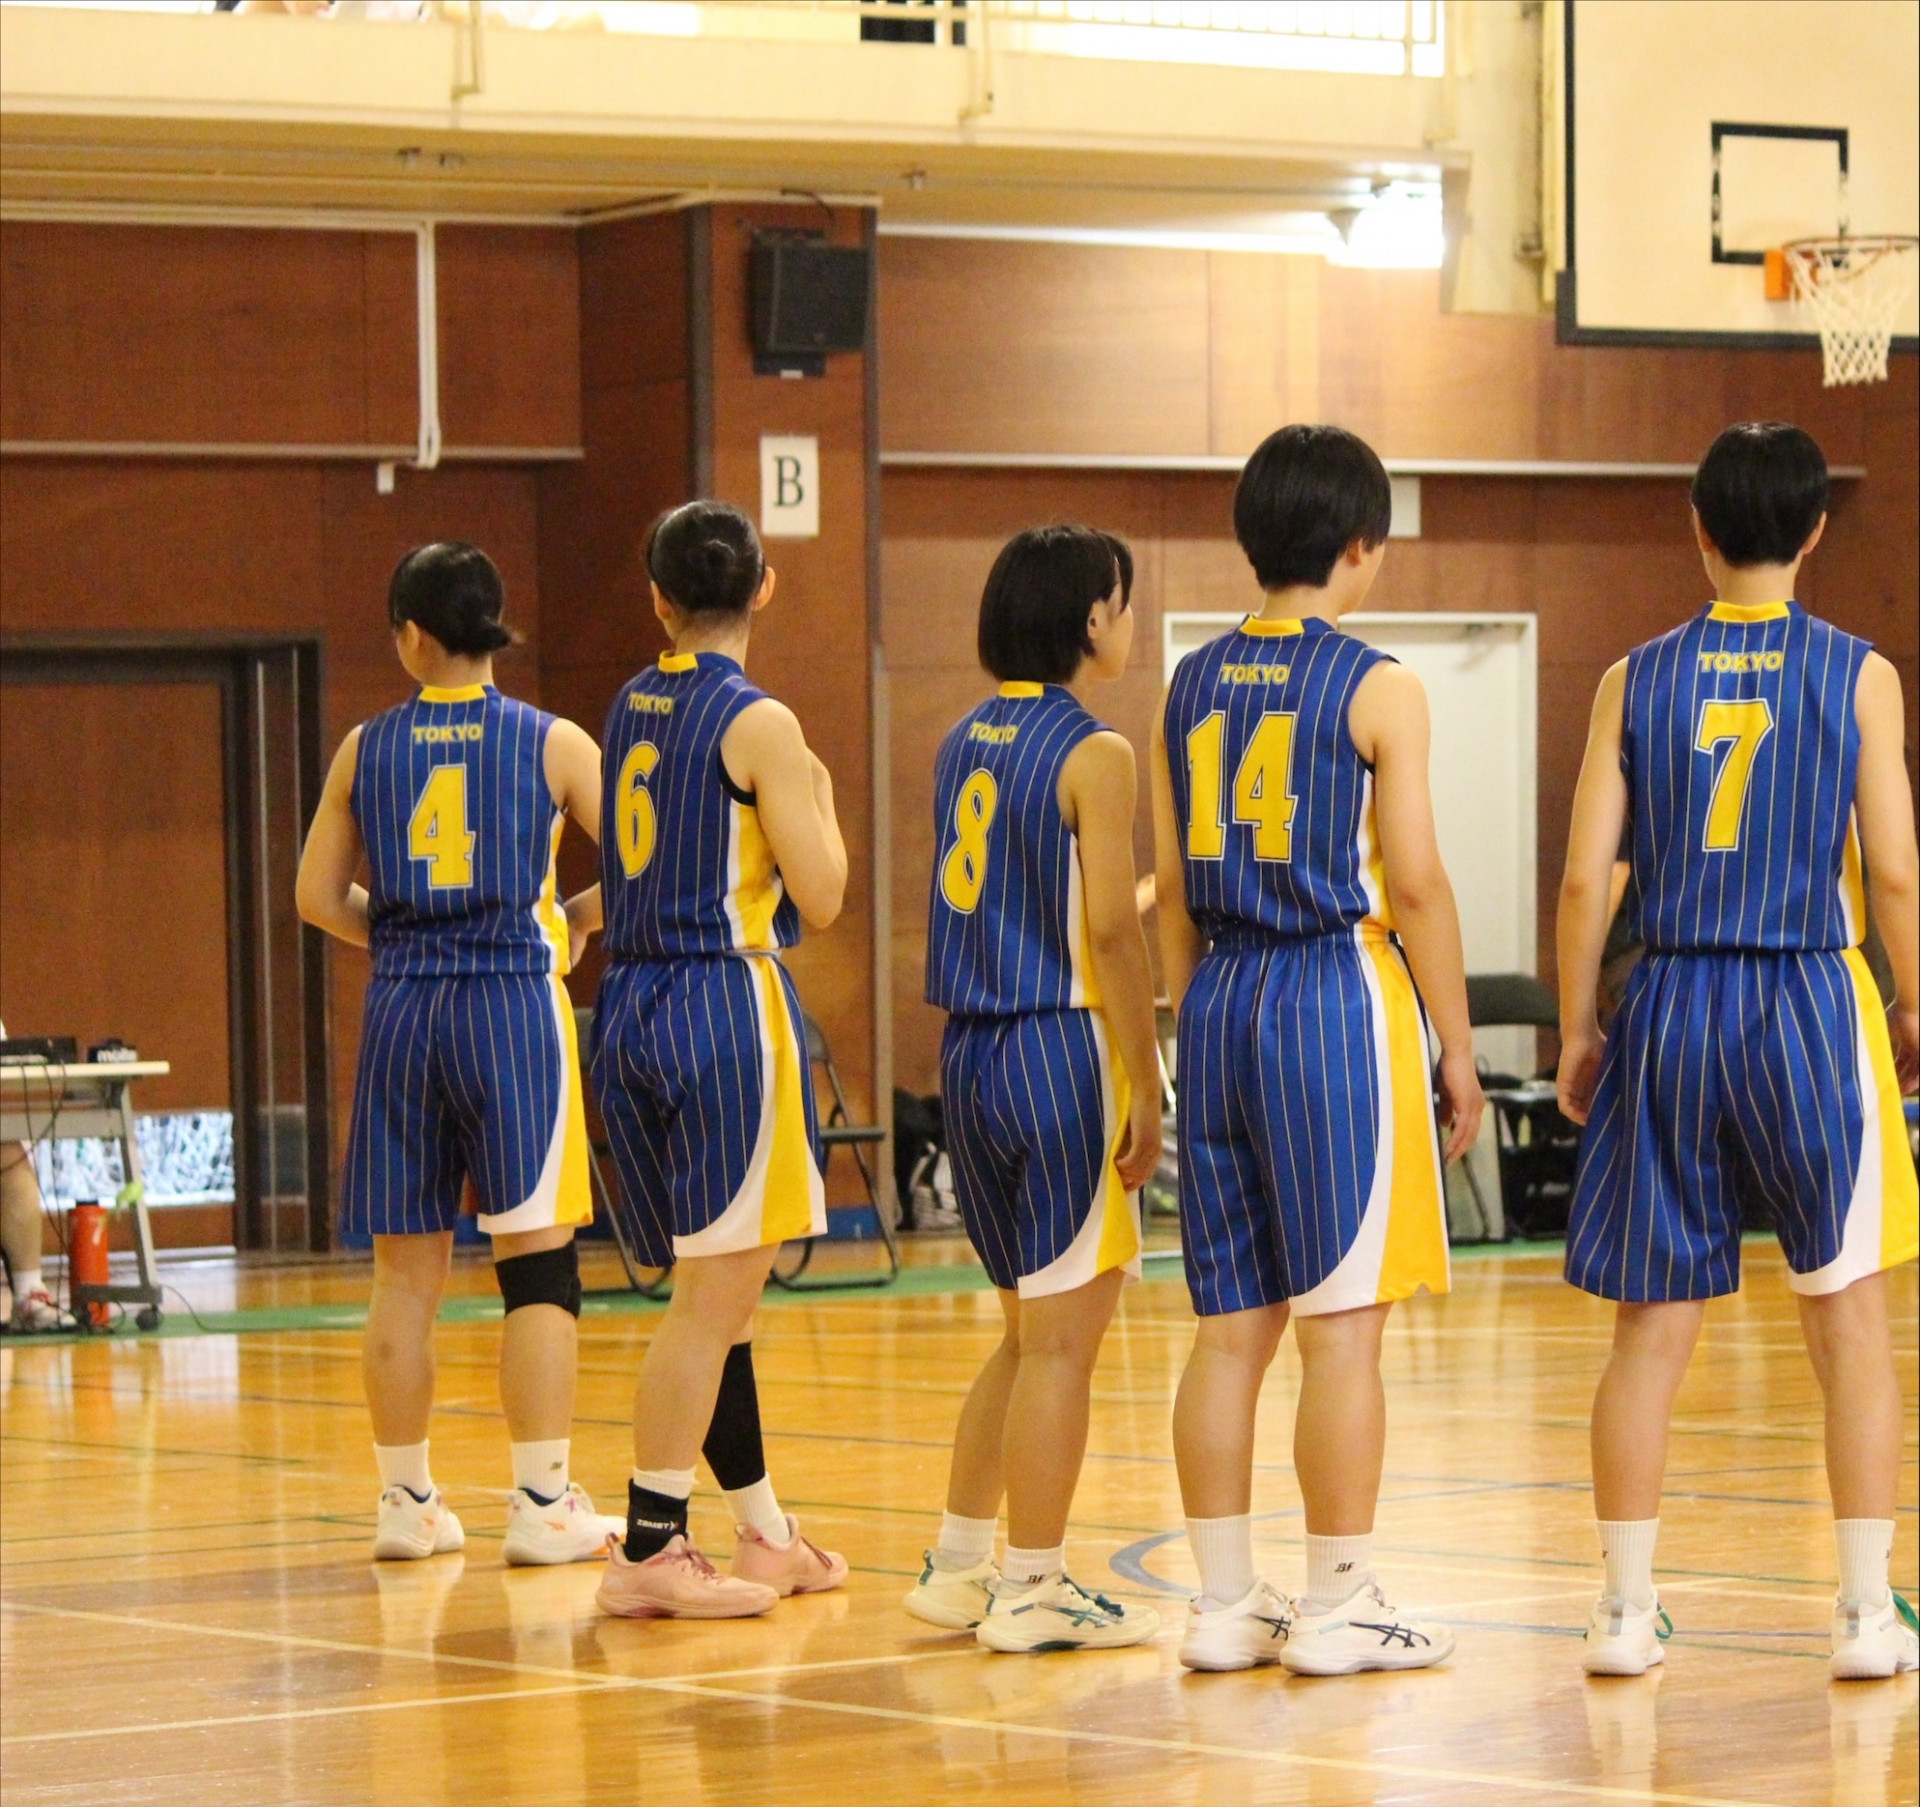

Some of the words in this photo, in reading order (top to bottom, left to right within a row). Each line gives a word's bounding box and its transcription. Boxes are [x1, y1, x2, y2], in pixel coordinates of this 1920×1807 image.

[773, 455, 804, 508] B
[1221, 663, 1290, 685] TOKYO
[1700, 650, 1783, 673] TOKYO
[628, 692, 673, 715] TOKYO
[412, 723, 483, 744] TOKYO
[968, 721, 1019, 744] TOKYO
[1187, 710, 1298, 863] 14
[1694, 698, 1774, 852] 7
[407, 763, 476, 889] 4
[615, 741, 660, 880] 6
[940, 768, 997, 914] 8
